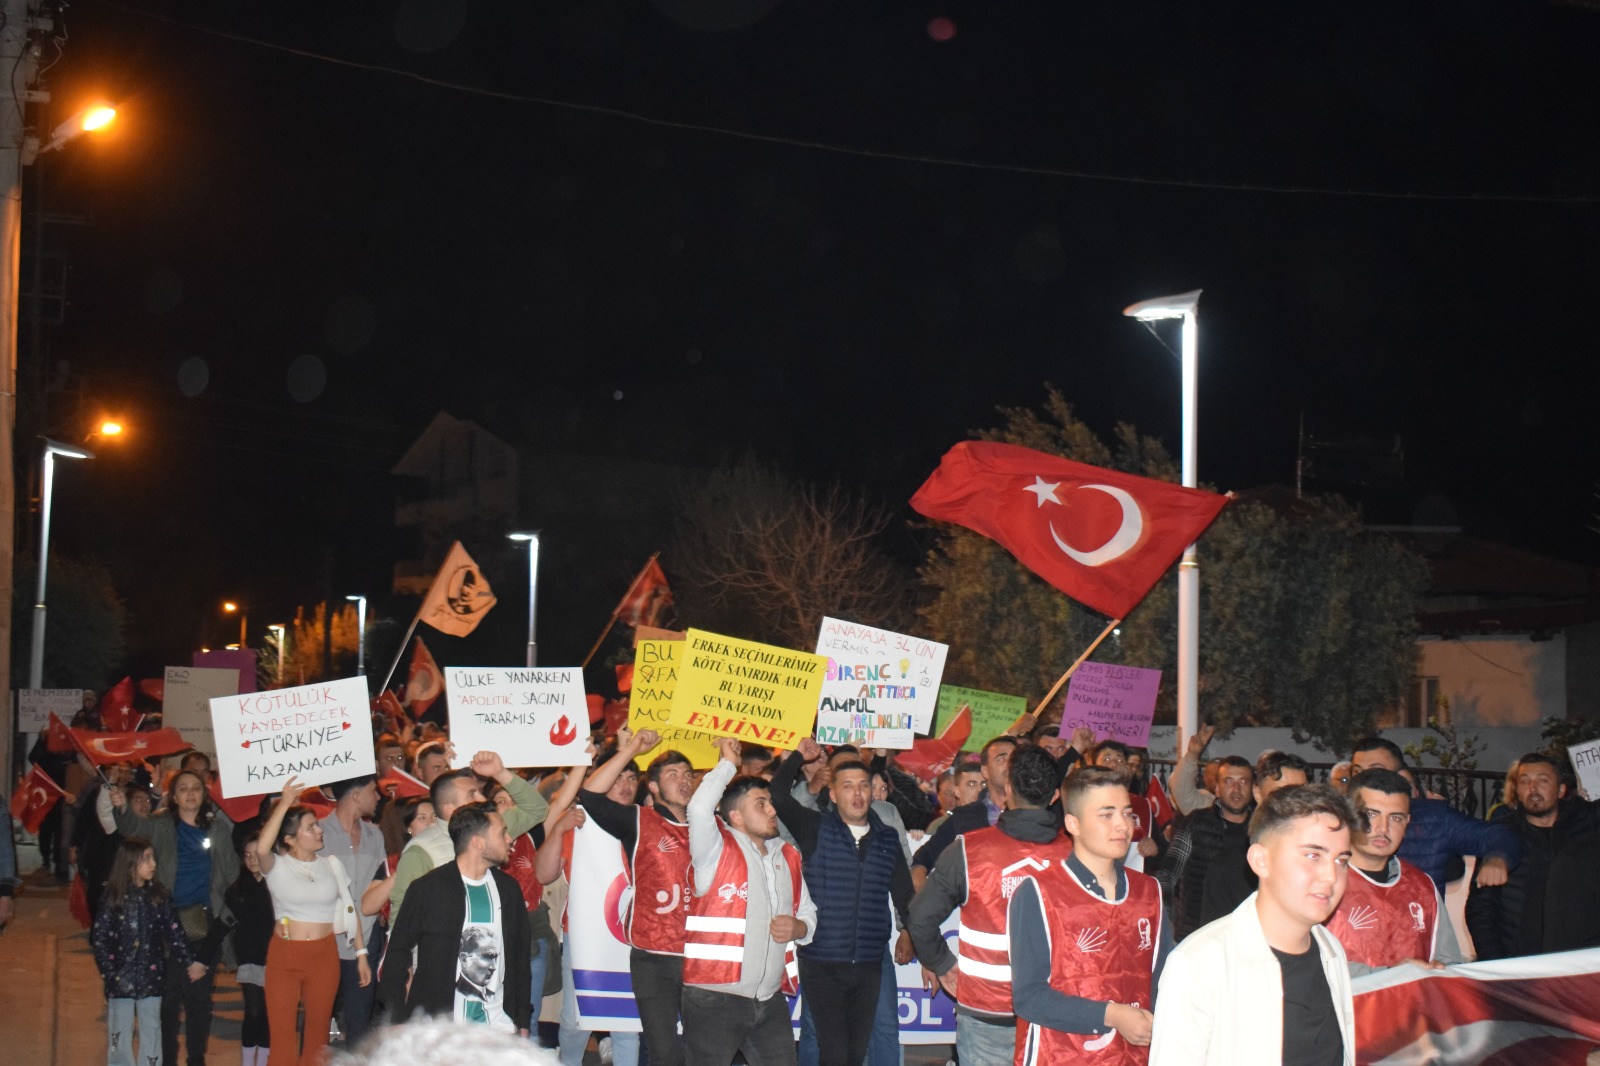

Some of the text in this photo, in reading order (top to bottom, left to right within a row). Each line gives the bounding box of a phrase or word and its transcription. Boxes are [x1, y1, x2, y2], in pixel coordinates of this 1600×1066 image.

[826, 622, 887, 646] ANAYASA
[642, 643, 674, 663] BU
[691, 638, 818, 674] ERKEK SEÇİMLERİMİZ
[455, 670, 571, 688] ÜLKE YANARKEN
[691, 655, 809, 690] KÖTÜ SANIRDIK AMA
[238, 687, 337, 716] KÖTÜLÜK
[719, 680, 776, 702] BU YARIŞI
[820, 697, 875, 713] AMPUL
[238, 706, 350, 736] KAYBEDECEK
[700, 695, 786, 722] SEN KAZANDIN
[250, 725, 344, 755] TÜRKİYE
[685, 711, 797, 746] EMİNE!
[247, 751, 357, 782] KAZANACAK
